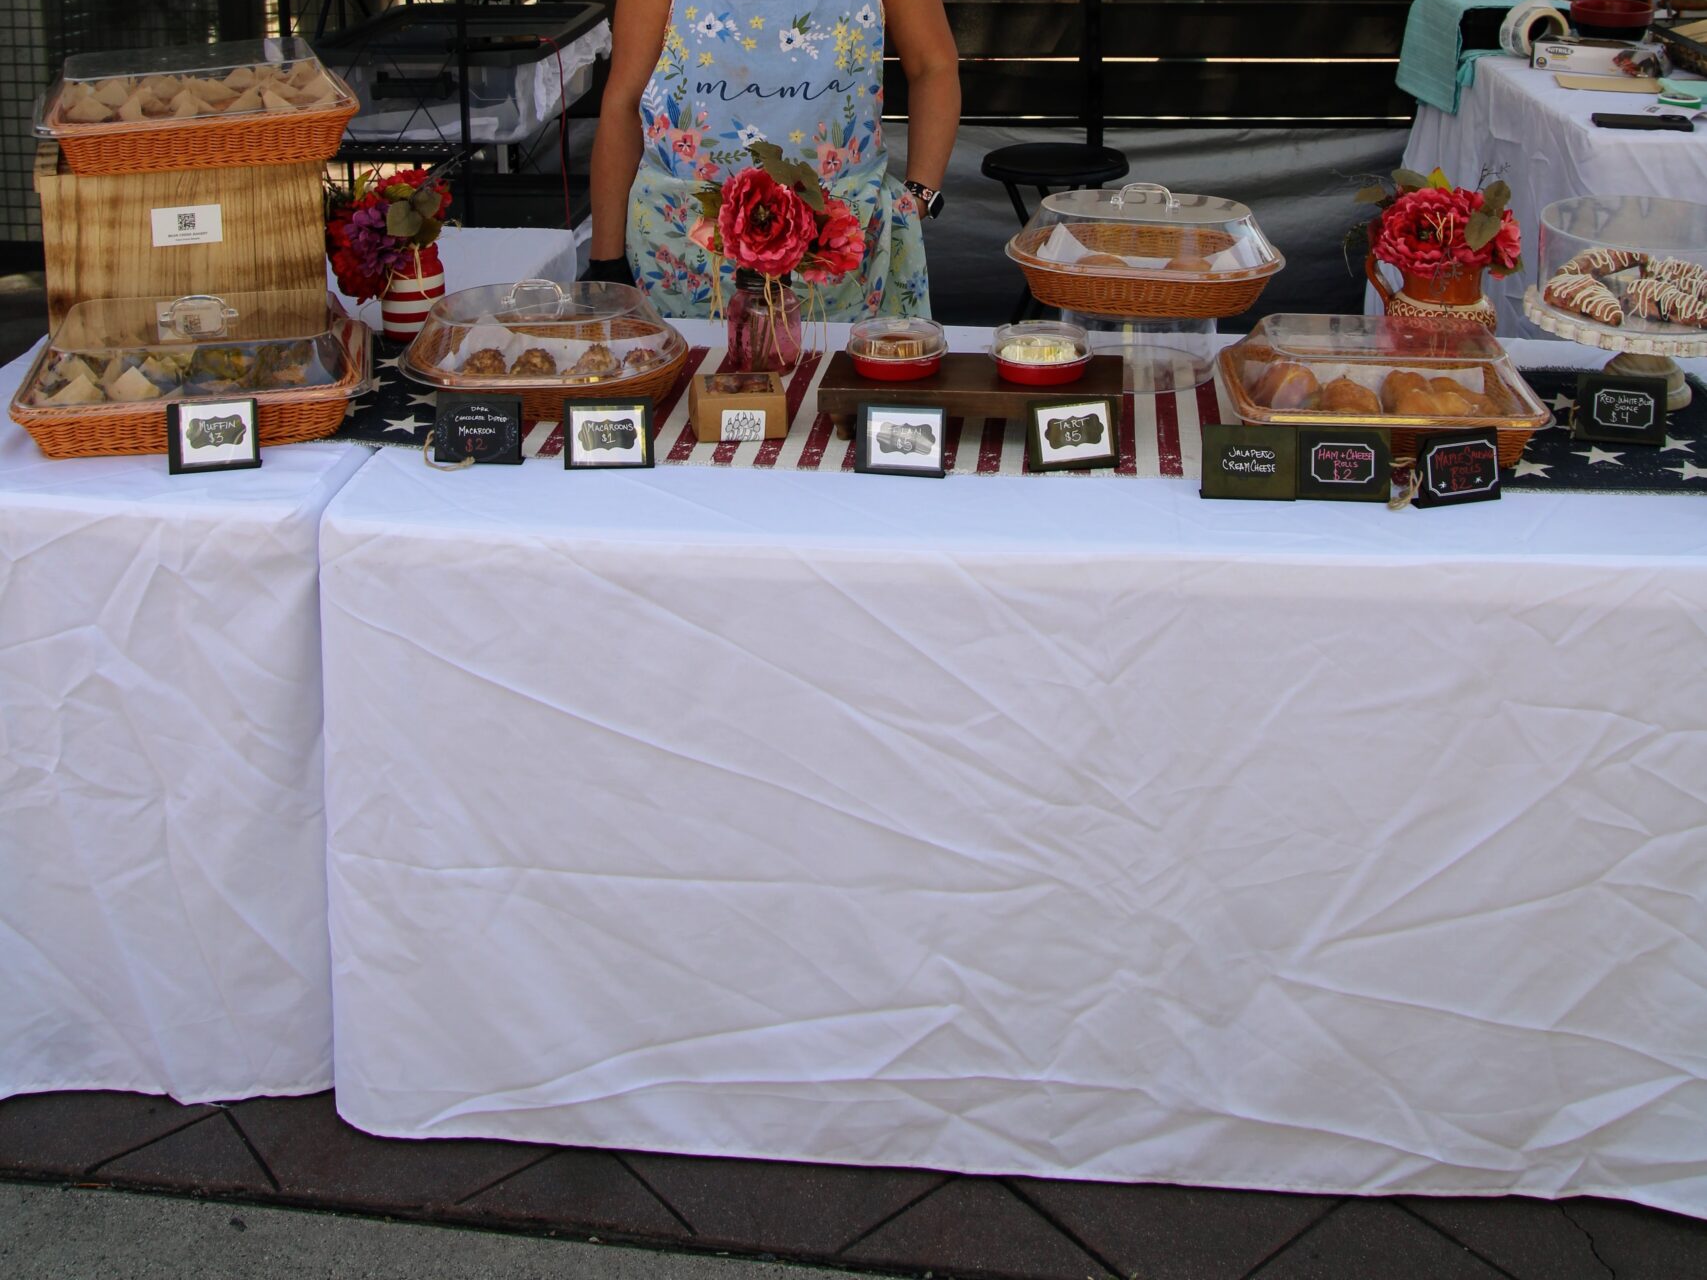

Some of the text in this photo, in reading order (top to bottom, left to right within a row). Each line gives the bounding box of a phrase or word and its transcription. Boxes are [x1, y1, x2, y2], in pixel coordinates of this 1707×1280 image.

[696, 79, 856, 101] mama
[199, 419, 236, 433] MUFFIN
[587, 422, 634, 432] MACAROONS
[1053, 417, 1090, 430] TART
[458, 425, 496, 436] MACAROON
[1064, 430, 1082, 442] $5
[208, 432, 224, 444] $3
[601, 432, 616, 444] $1
[896, 437, 913, 451] $5
[1318, 448, 1339, 460] HAM
[1333, 460, 1359, 468] ROLLS
